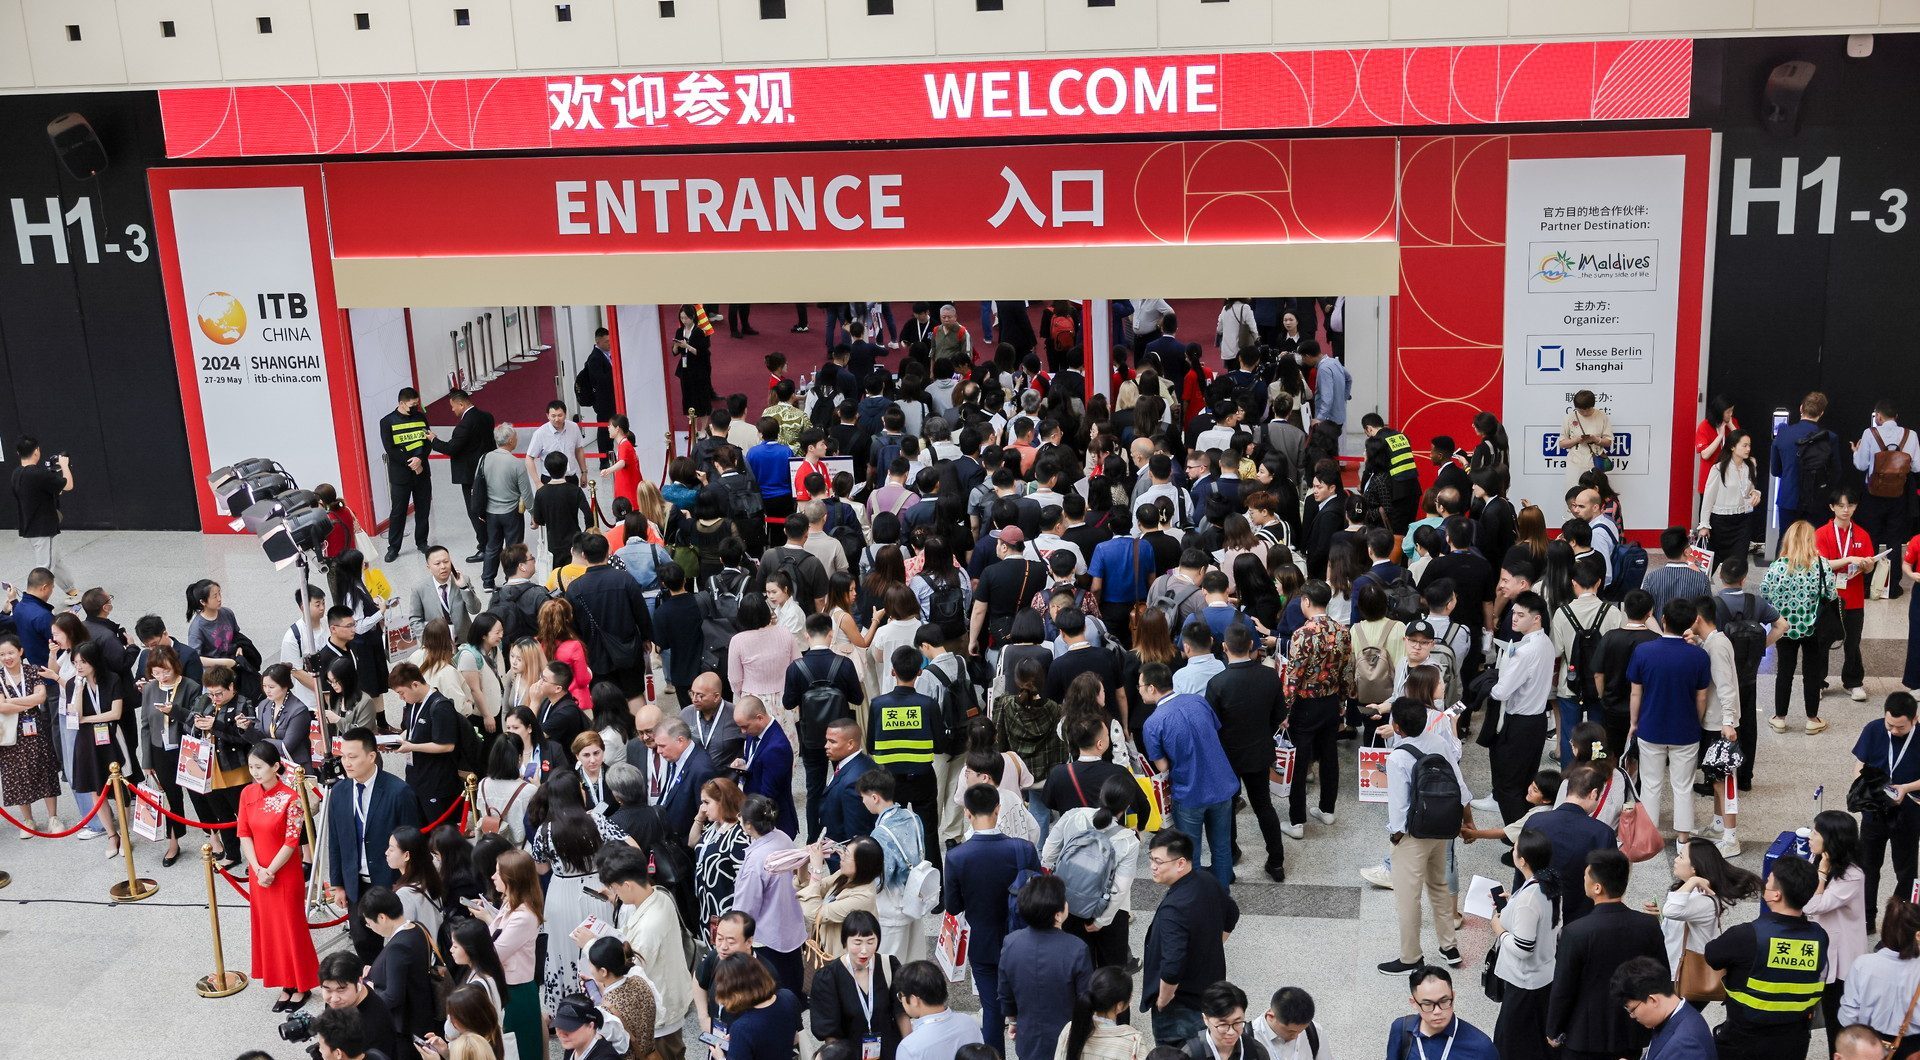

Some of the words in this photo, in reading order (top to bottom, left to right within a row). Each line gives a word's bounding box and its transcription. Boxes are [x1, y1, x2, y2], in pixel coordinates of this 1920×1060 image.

[923, 64, 1219, 120] WELCOME
[548, 71, 796, 131] 欢迎参观
[986, 165, 1106, 229] 入口
[1730, 156, 1909, 236] H1-3
[554, 173, 906, 236] ENTRANCE
[10, 196, 149, 265] H1-3
[1540, 221, 1582, 232] Partner
[1584, 219, 1651, 231] Destination:
[1578, 252, 1651, 271] Maldives
[257, 292, 308, 320] ITB
[1573, 300, 1611, 312] 主办方:
[1563, 314, 1620, 327] Organizer:
[262, 327, 312, 342] CHINA
[1575, 347, 1608, 357] Messe
[1611, 346, 1642, 357] Berlin
[200, 356, 241, 371] 2024
[250, 355, 320, 370] SHANGHAI
[1575, 361, 1624, 373] Shanghai
[204, 376, 226, 384] 27-29
[226, 376, 243, 386] May
[254, 373, 322, 384] itb-china.com
[886, 710, 917, 720] 安保
[1776, 942, 1814, 956] 安保
[1771, 956, 1815, 967] ANBAO
